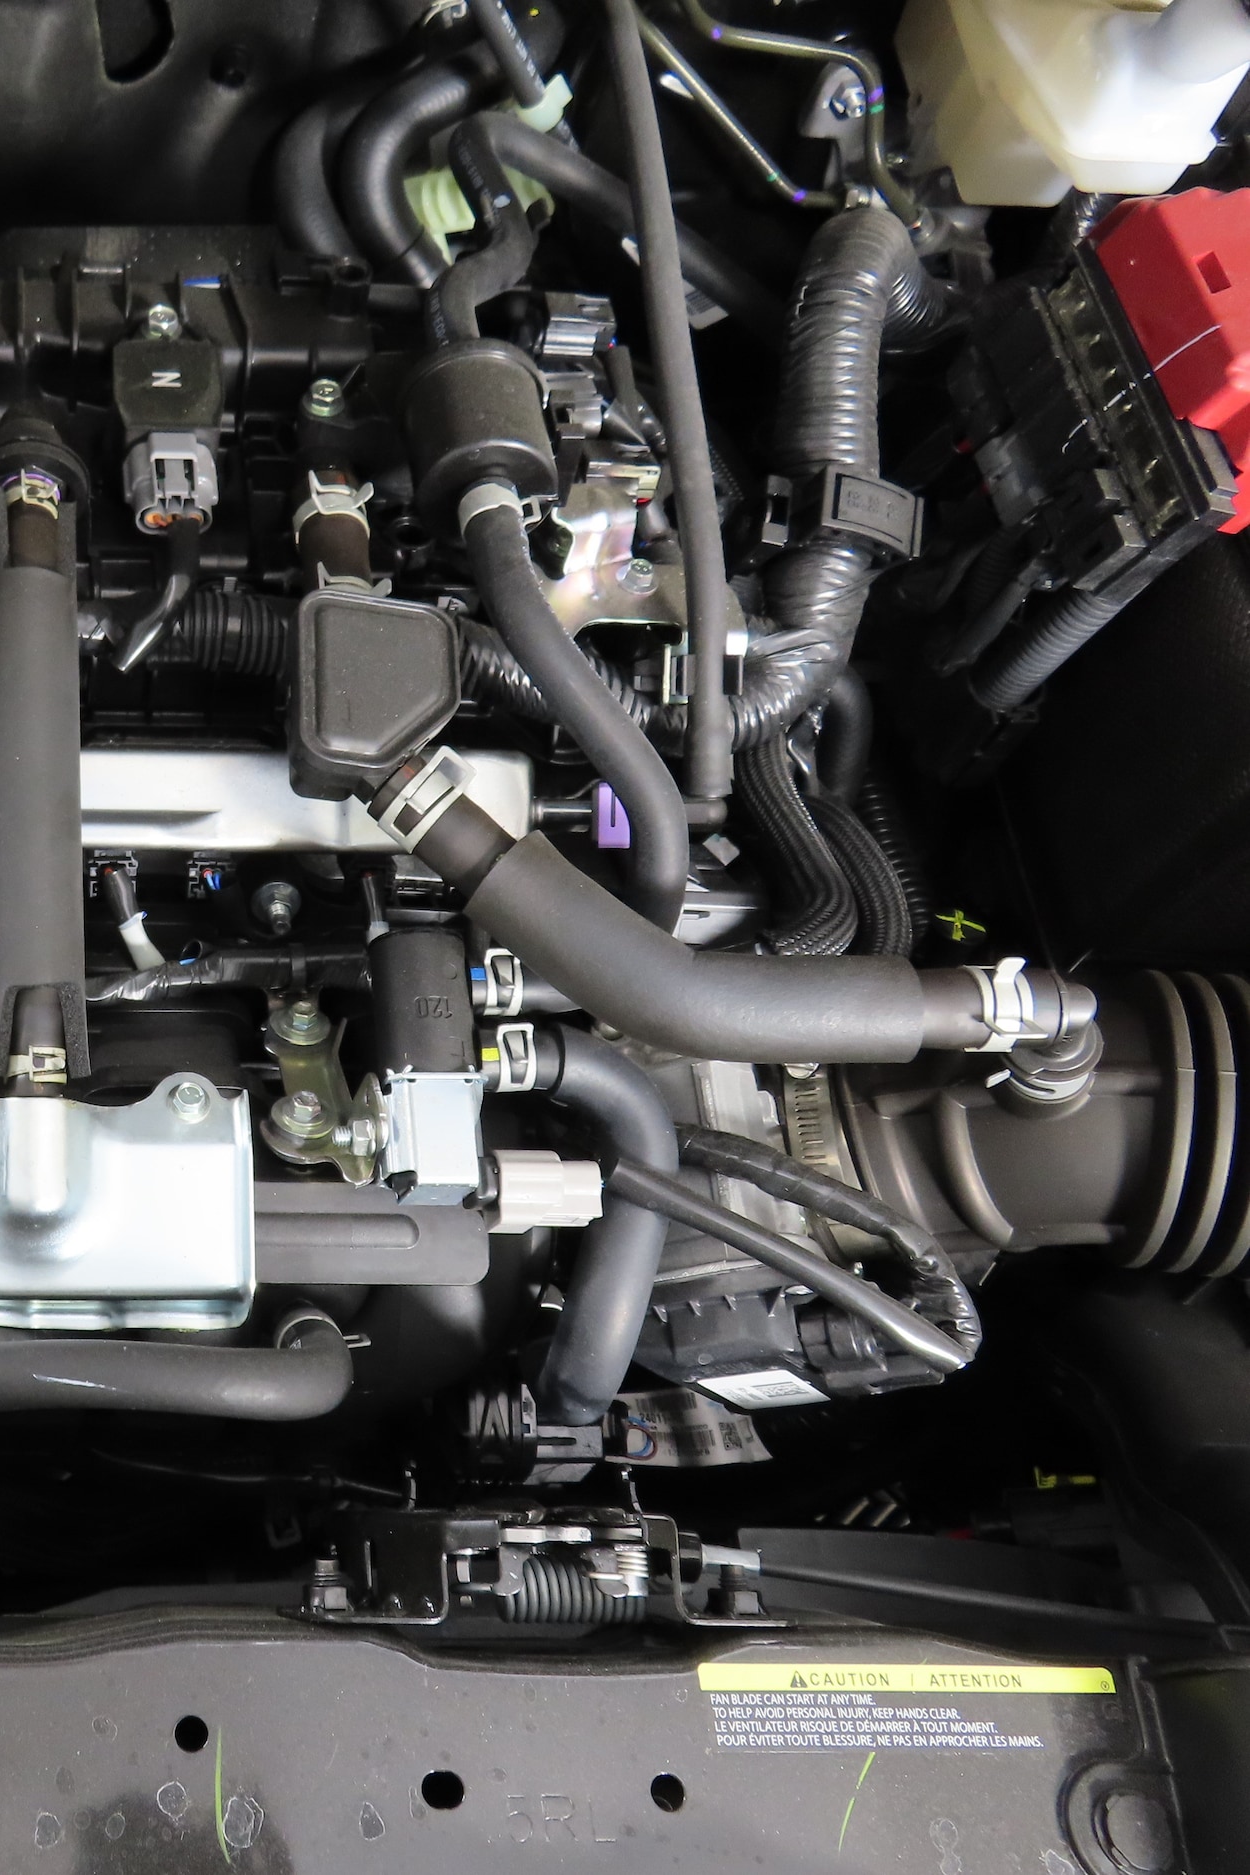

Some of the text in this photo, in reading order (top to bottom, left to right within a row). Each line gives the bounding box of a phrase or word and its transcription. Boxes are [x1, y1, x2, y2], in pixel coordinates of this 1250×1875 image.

[809, 1672, 890, 1687] CAUTION
[930, 1673, 1022, 1688] ATTENTION
[710, 1693, 876, 1706] FAN BLADE CAN START AT ANY TIME.
[713, 1707, 961, 1721] TO HELP AVOID PERSONAL INJURY, KEEP HANDS CLEAR.
[714, 1719, 998, 1734] LE VENTILATEUR RISQUE DE DÉMARRER À TOUT MOMENT.
[717, 1732, 1044, 1748] POUR ÉVITER TOUTE BLESSURE, NE PAS EN APPROCHER LES MAINS.
[506, 1794, 617, 1843] 5RL
